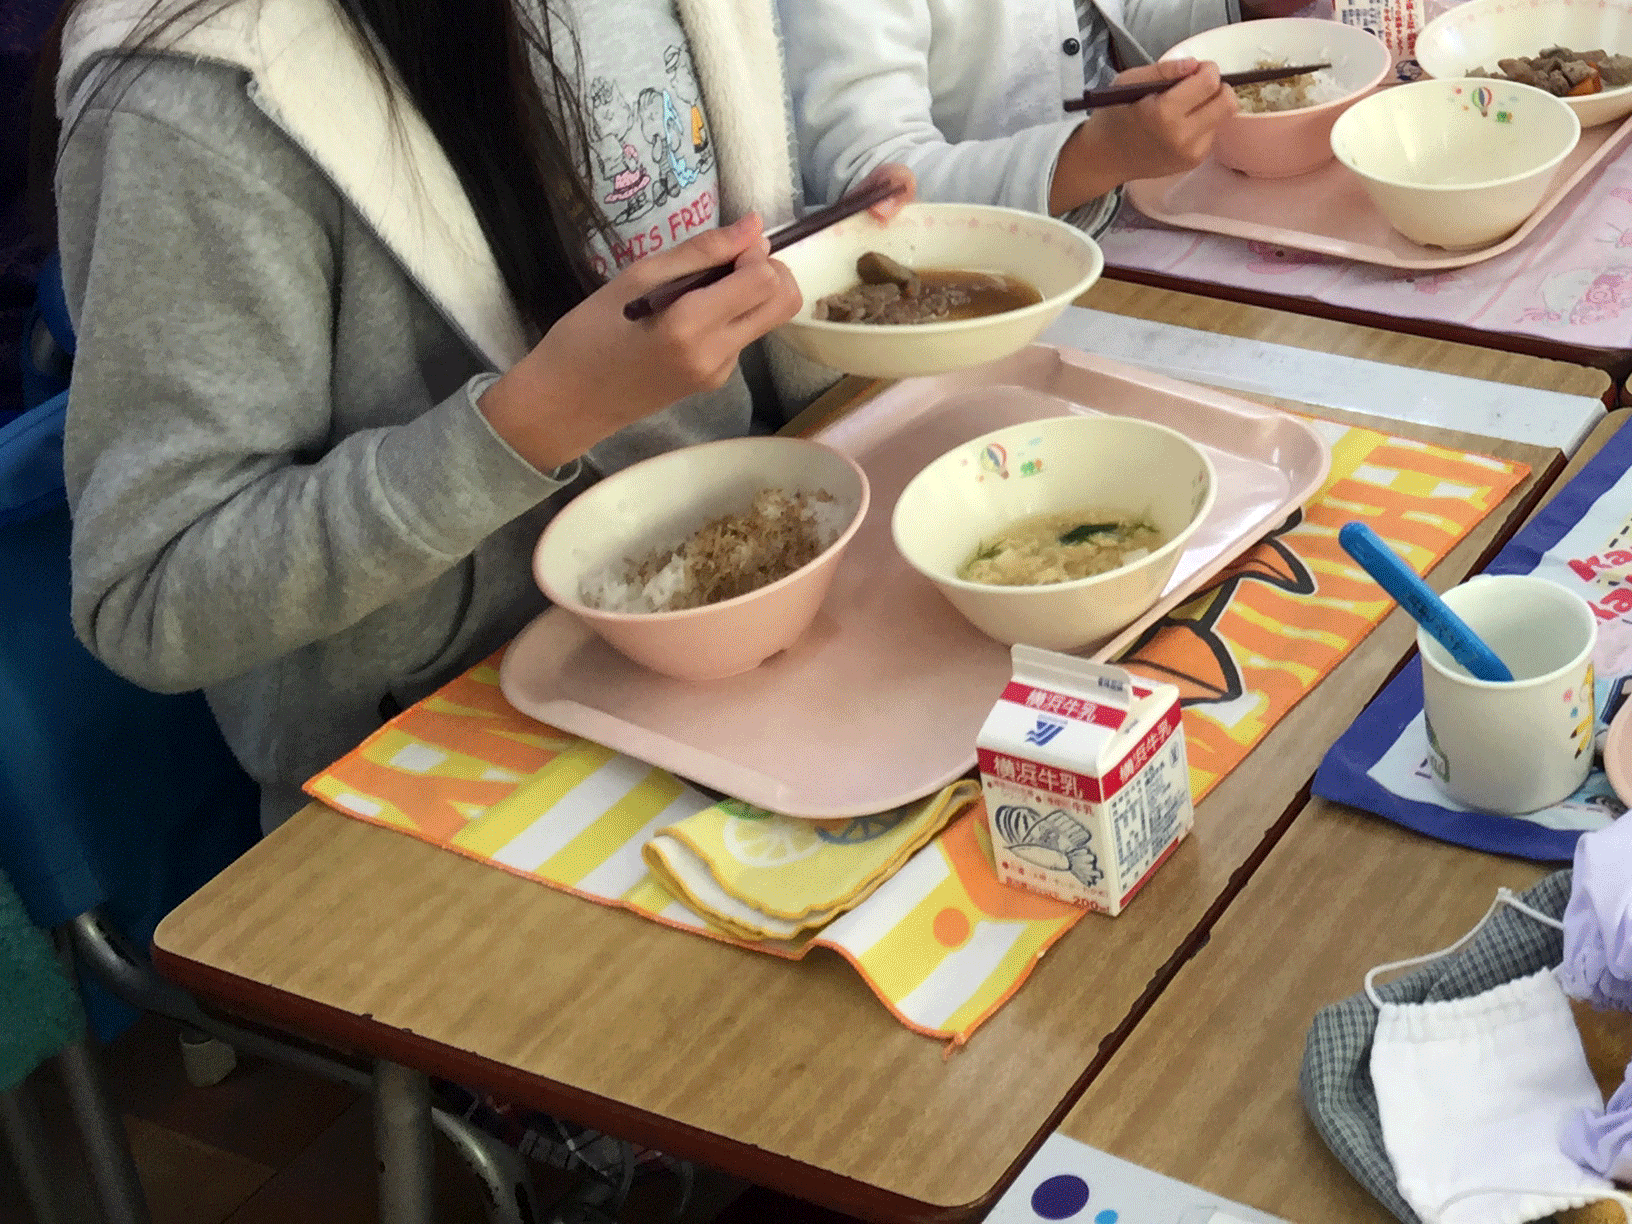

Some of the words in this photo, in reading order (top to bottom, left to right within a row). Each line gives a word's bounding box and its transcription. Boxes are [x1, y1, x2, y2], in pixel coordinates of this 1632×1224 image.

[612, 225, 663, 270] HIS
[667, 192, 717, 242] FRIE
[1026, 689, 1097, 723] 横浜牛乳
[994, 756, 1084, 800] 横浜牛乳
